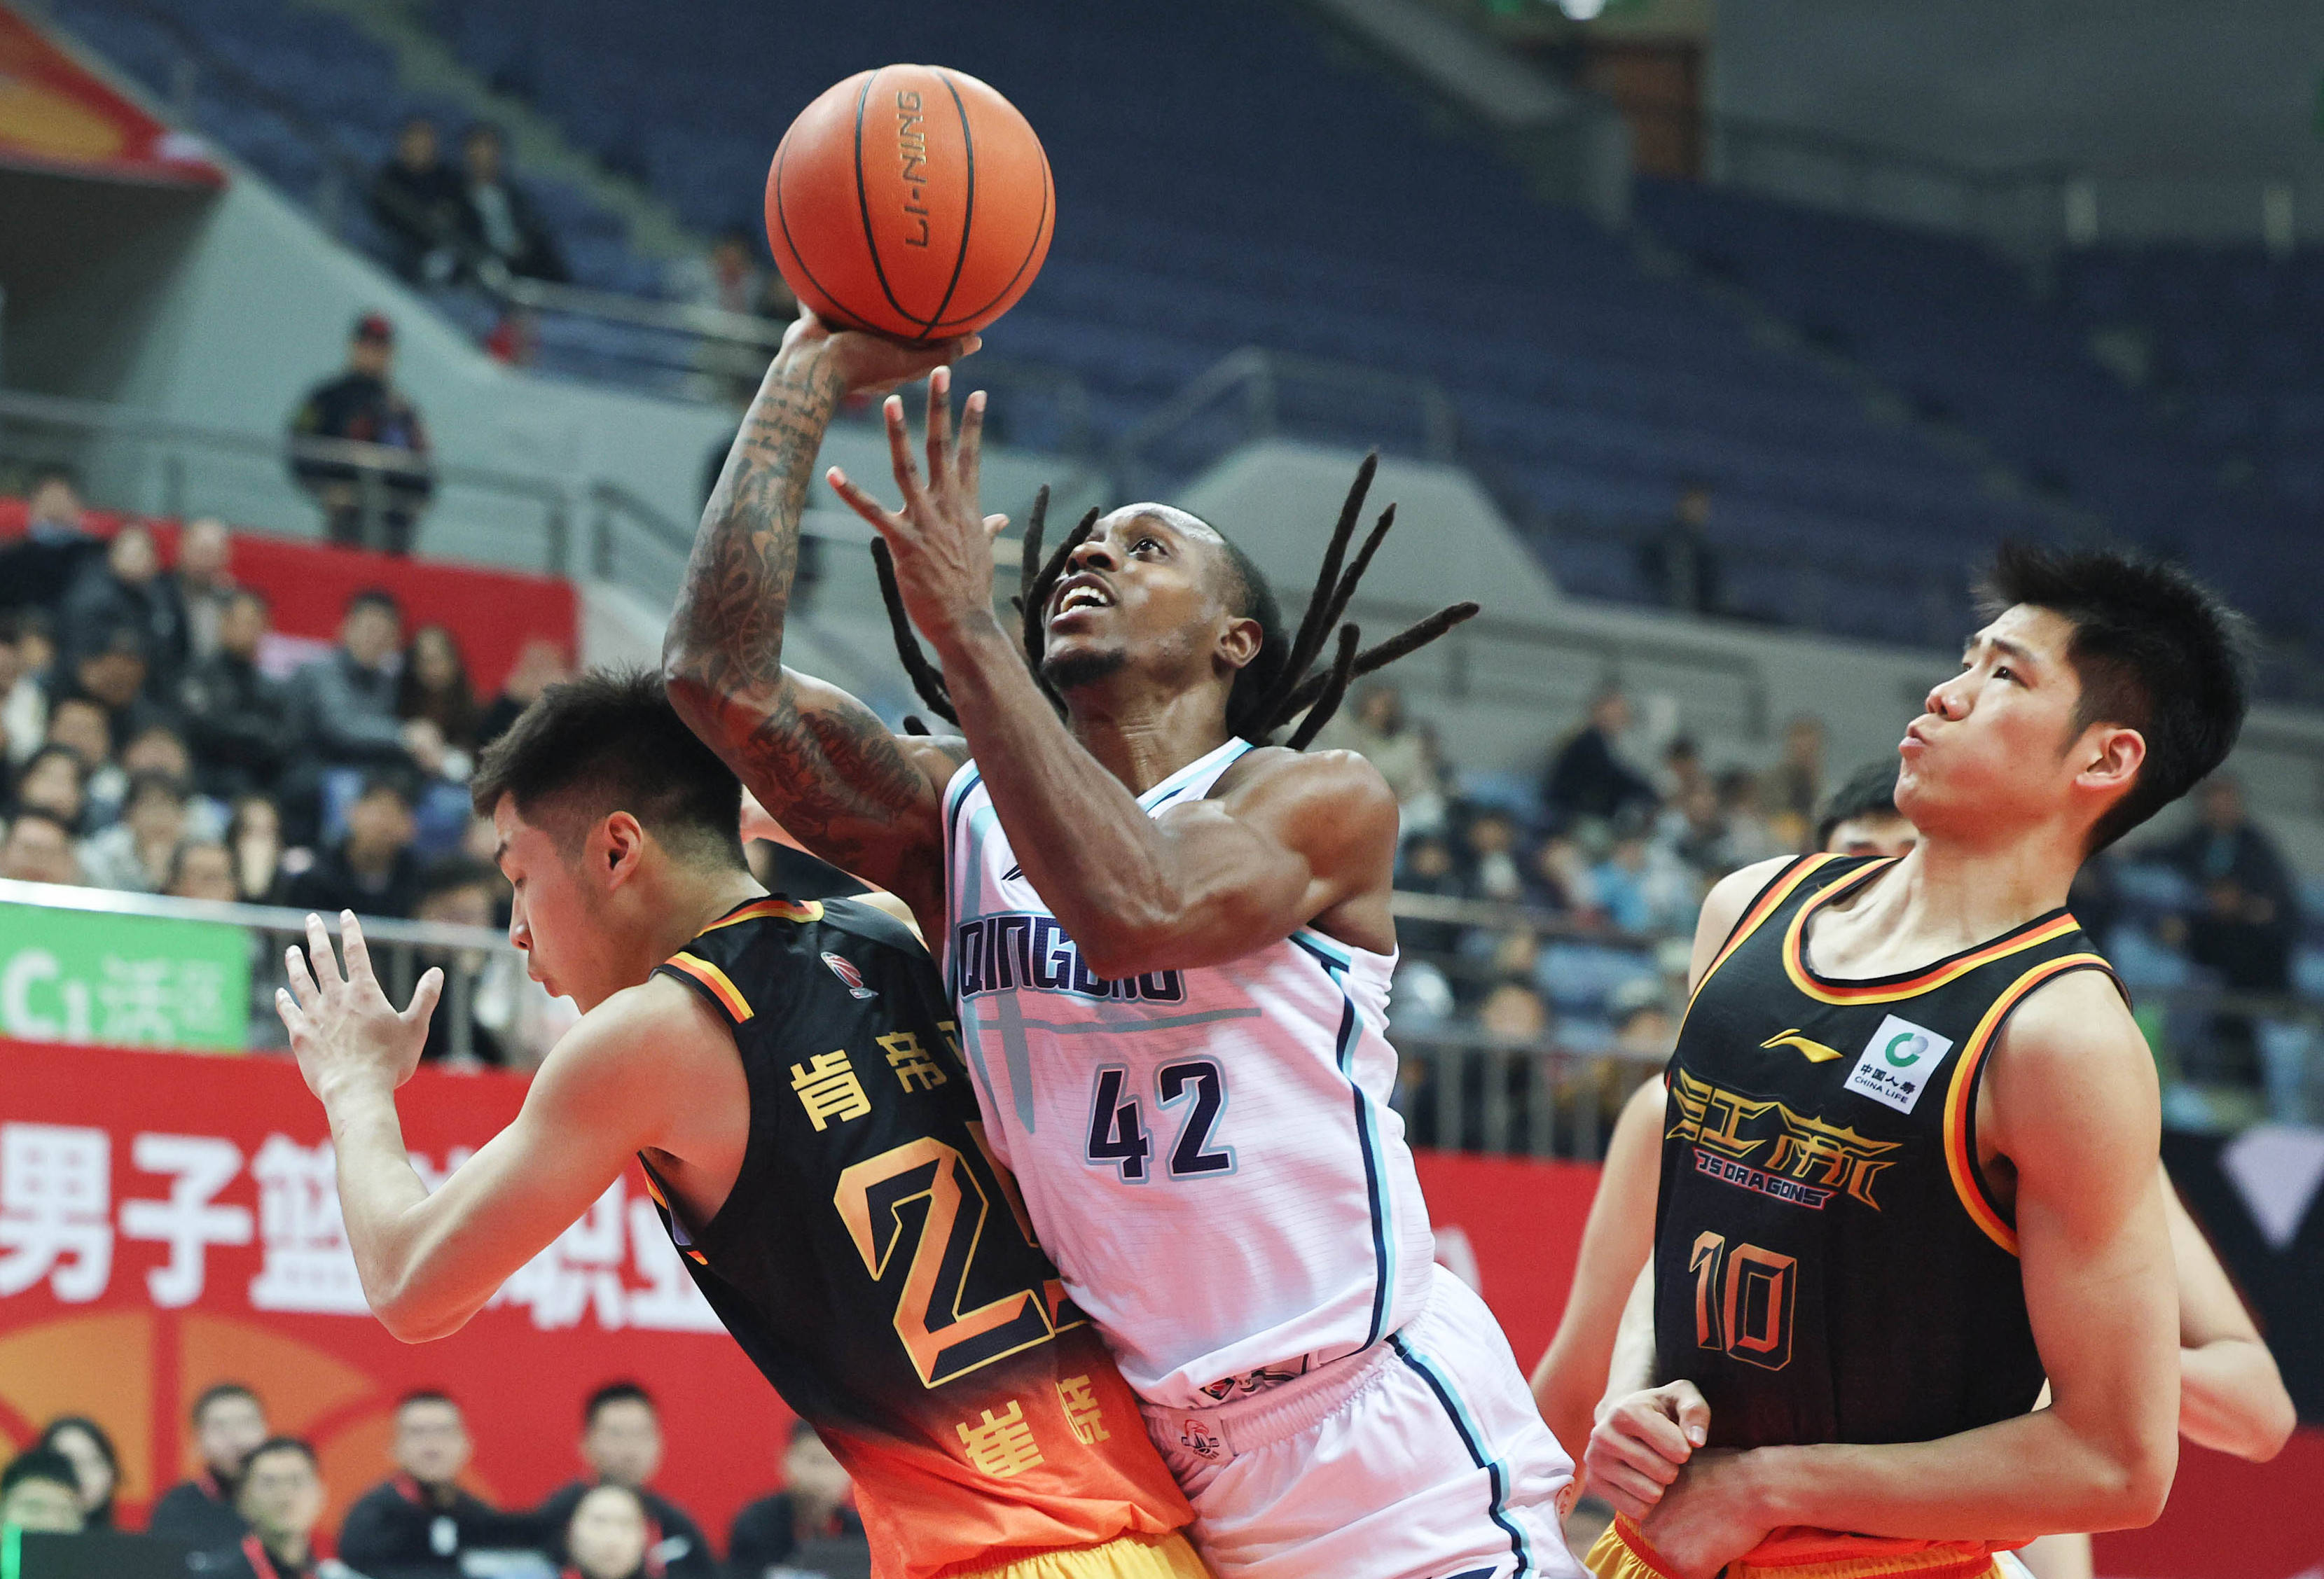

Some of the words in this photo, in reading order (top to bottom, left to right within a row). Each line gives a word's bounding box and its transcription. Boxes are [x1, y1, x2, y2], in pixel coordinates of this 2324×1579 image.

[897, 90, 929, 248] LI-NING
[1086, 1055, 1236, 1183] 42
[1854, 1076, 1883, 1094] CHINA
[1885, 1089, 1909, 1104] LIFE
[1860, 1063, 1916, 1094] 中国人寿
[1689, 1230, 1797, 1371] 10
